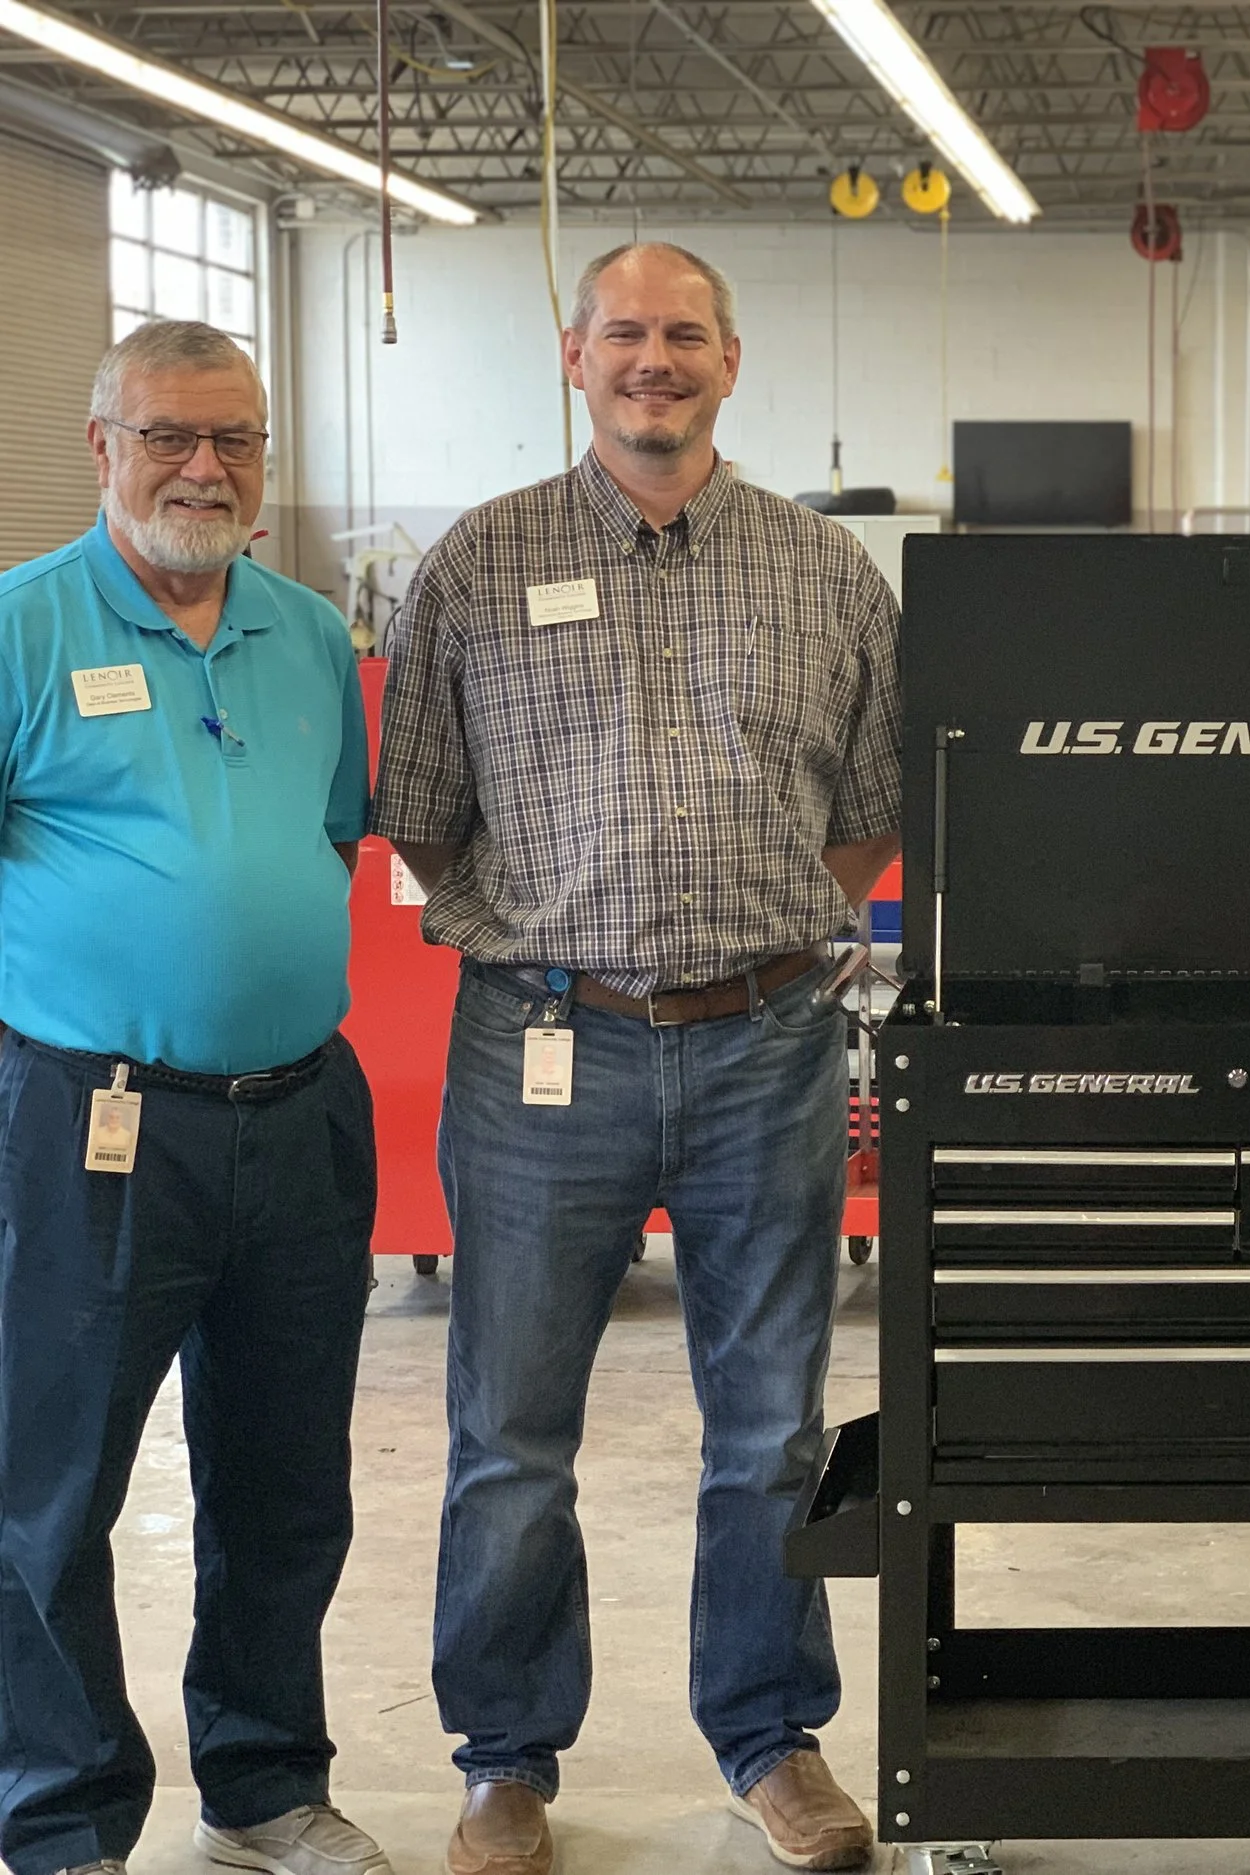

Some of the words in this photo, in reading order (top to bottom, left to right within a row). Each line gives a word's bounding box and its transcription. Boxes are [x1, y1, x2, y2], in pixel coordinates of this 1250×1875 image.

[83, 669, 132, 682] LENOIR
[1019, 721, 1125, 755] U.S.
[964, 1073, 1025, 1094] U.S.
[1028, 1073, 1201, 1094] GENERAL
